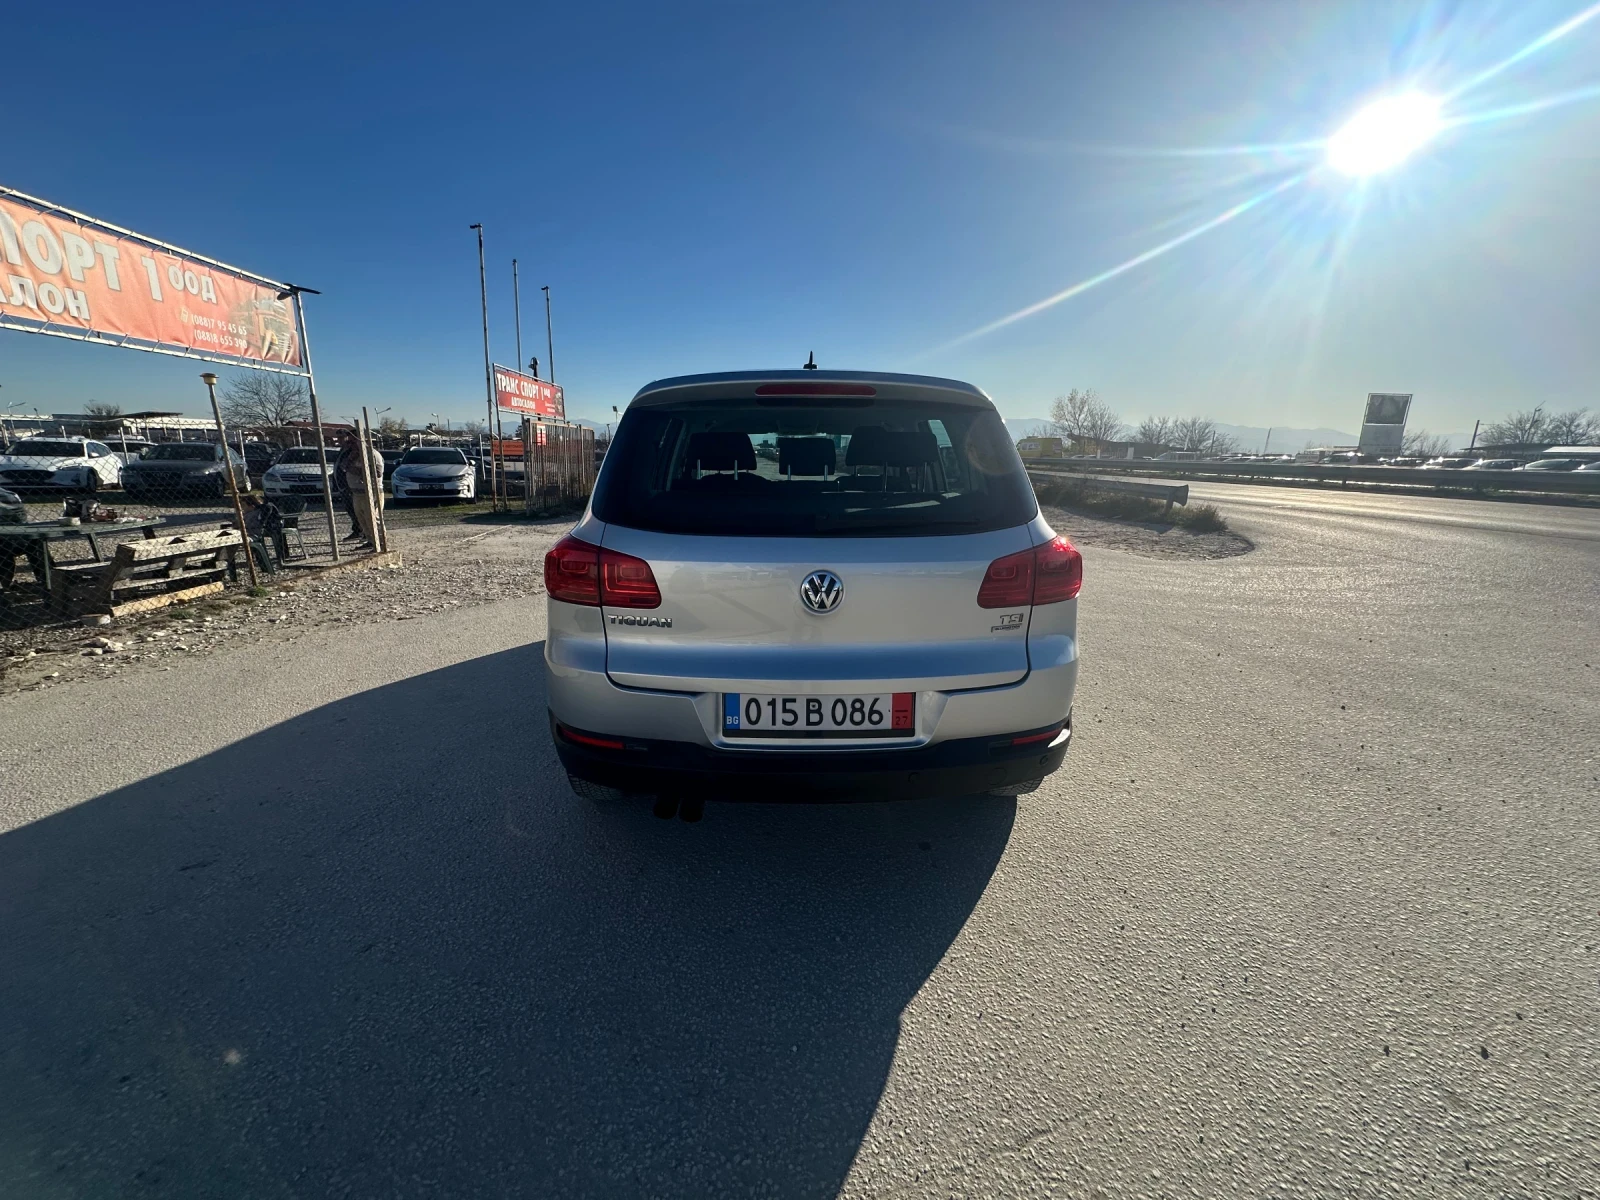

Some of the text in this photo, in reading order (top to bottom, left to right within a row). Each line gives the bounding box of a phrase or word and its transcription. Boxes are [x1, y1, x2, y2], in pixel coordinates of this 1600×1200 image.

[141, 256, 163, 302] 1
[168, 264, 218, 304] ООД
[0, 274, 91, 320] ЛОН
[607, 614, 673, 628] TIGUAN
[726, 716, 739, 725] BG
